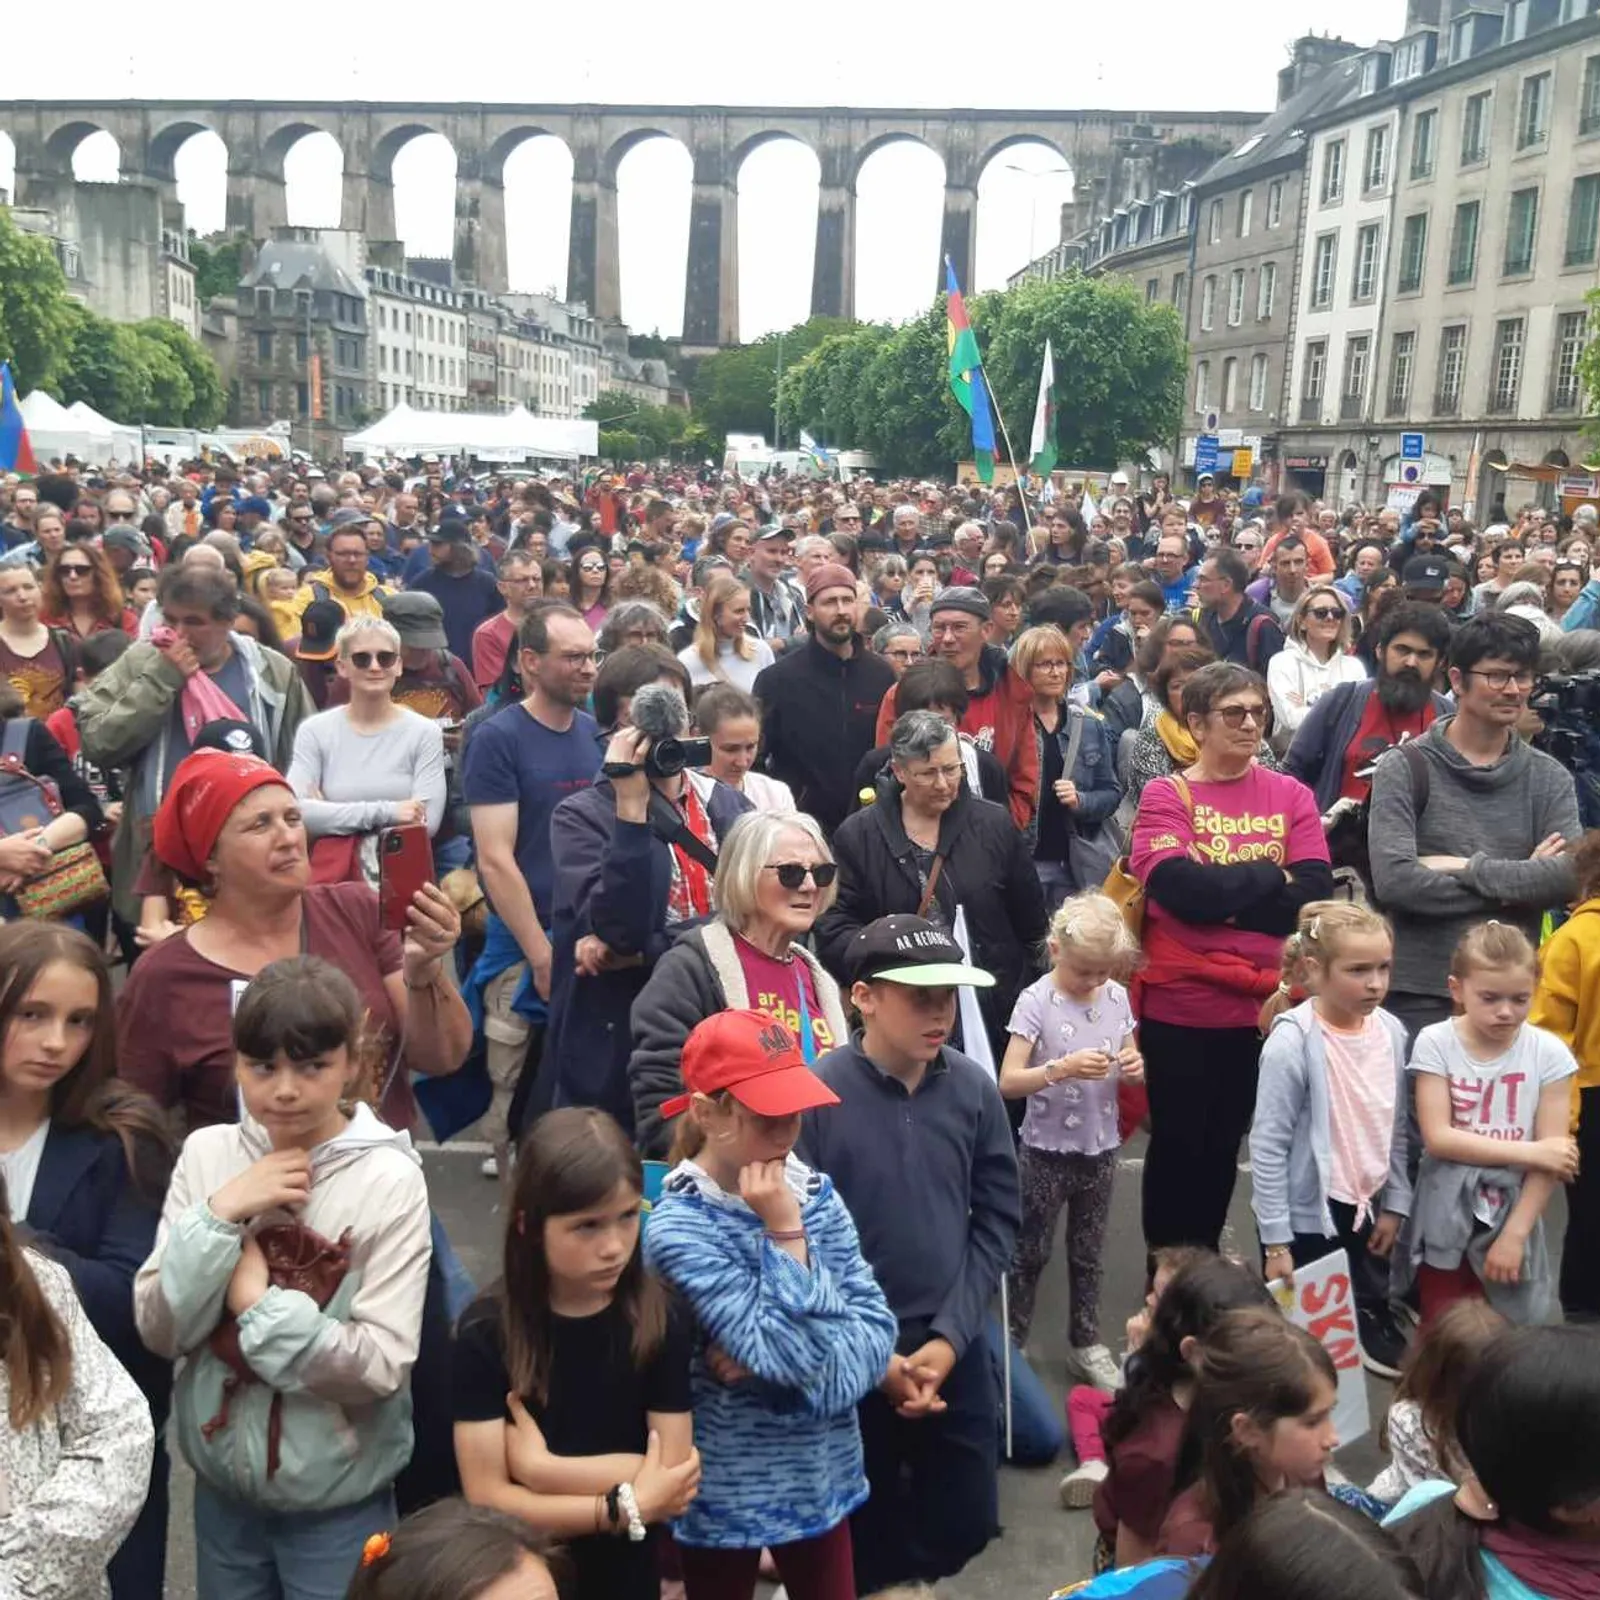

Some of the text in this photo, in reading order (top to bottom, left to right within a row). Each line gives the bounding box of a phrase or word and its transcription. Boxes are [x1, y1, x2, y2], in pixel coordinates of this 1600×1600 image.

[1195, 805, 1213, 815] ar
[896, 935, 913, 950] AR
[758, 992, 777, 1006] ar
